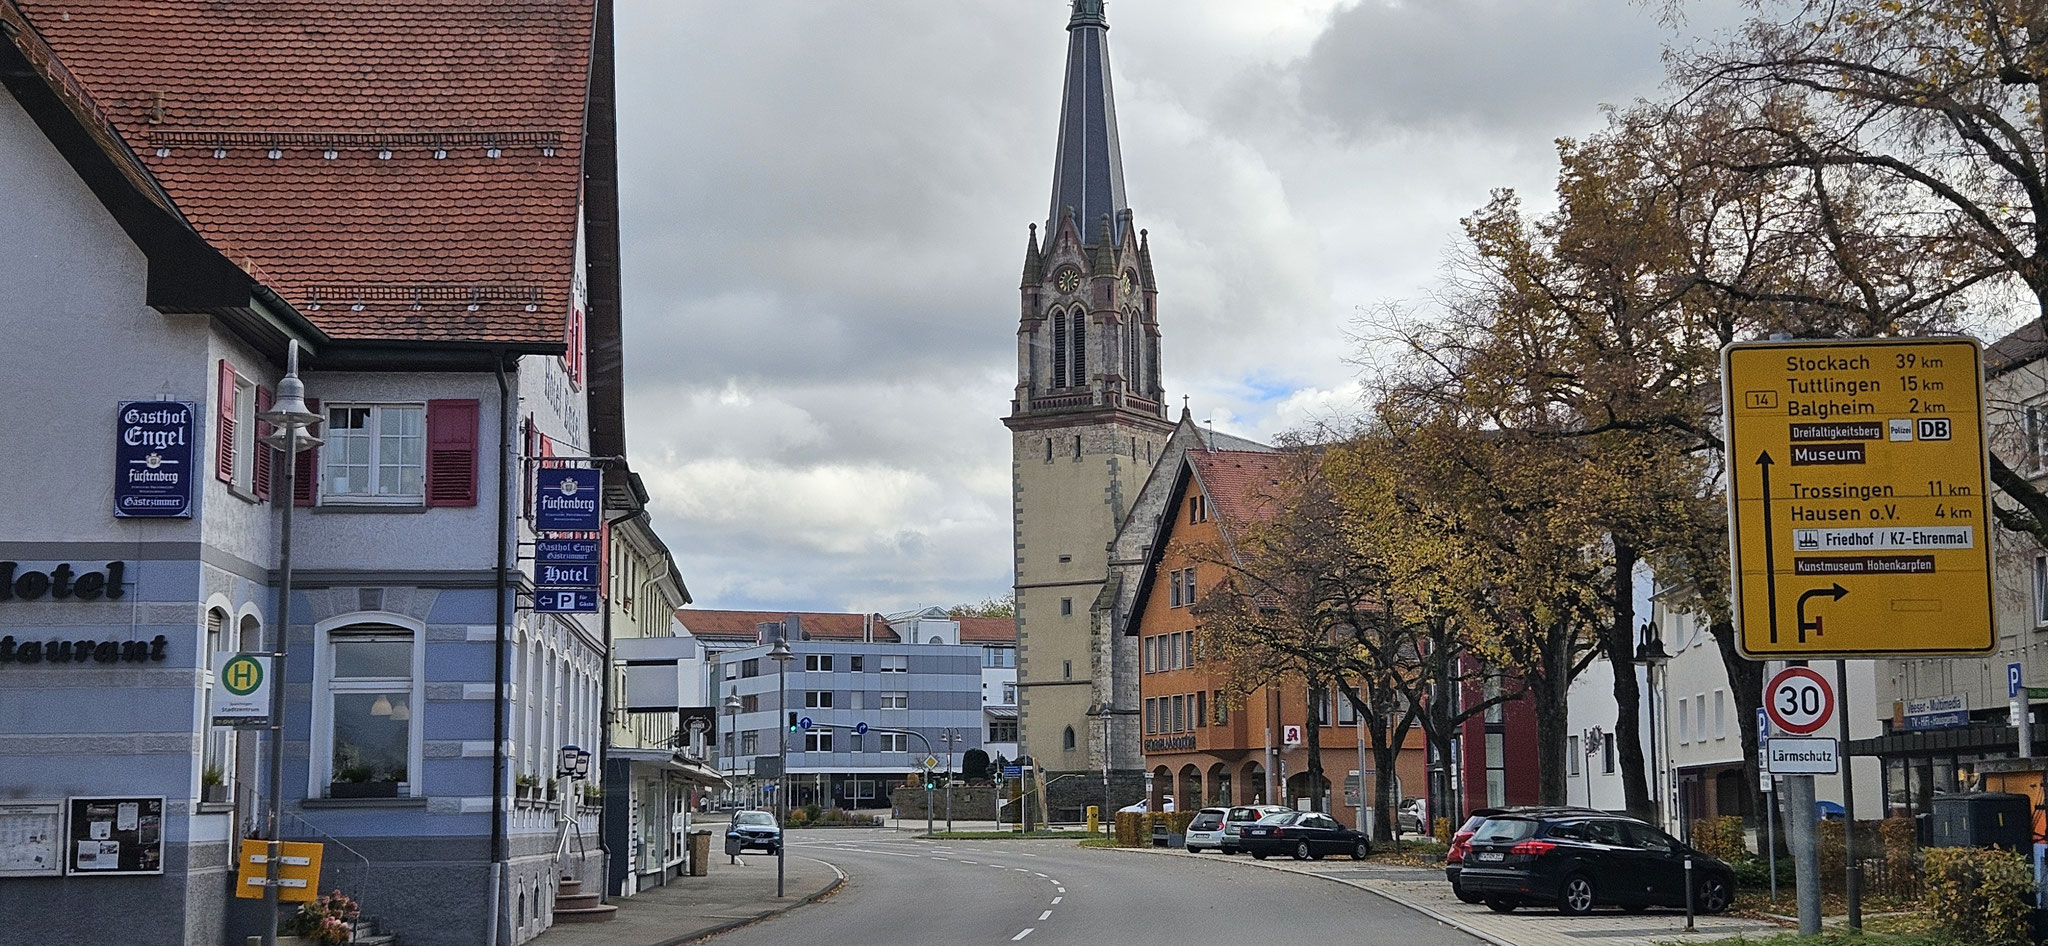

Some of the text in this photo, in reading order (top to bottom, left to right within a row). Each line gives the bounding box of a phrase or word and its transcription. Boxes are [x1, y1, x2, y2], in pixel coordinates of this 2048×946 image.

[1787, 353, 1943, 371] Stockach 39 km
[1787, 376, 1944, 396] Tuttlingen 15 km
[1754, 394, 1768, 405] 14
[1788, 398, 1945, 419] Balgheim 2 km
[124, 409, 187, 426] Gasthof
[124, 426, 185, 449] Engel
[1793, 426, 1880, 439] Dreifaltigkeitsberg
[1891, 427, 1911, 435] Polizei
[1921, 422, 1947, 438] DB
[1795, 448, 1861, 461] Museum
[129, 469, 178, 484] Fürstenberg
[1790, 480, 1970, 501] Trossingen 11 km
[124, 497, 180, 507] Gästezimmer
[542, 495, 594, 512] Fürstenberg
[1791, 504, 1972, 521] Hausen o.V. 4 km
[1826, 532, 1874, 546] Friedhof
[1890, 531, 1968, 545] KZ-Ehrenmal
[538, 543, 597, 553] Gasthof Engel
[1798, 559, 1931, 573] Kunstmuseum Hohenkarpfen
[544, 566, 589, 584] Hotel
[560, 594, 572, 608] P
[234, 664, 251, 686] H
[2010, 667, 2019, 694] P
[1779, 685, 1819, 716] 30
[1772, 749, 1832, 762] Lärmschutz
